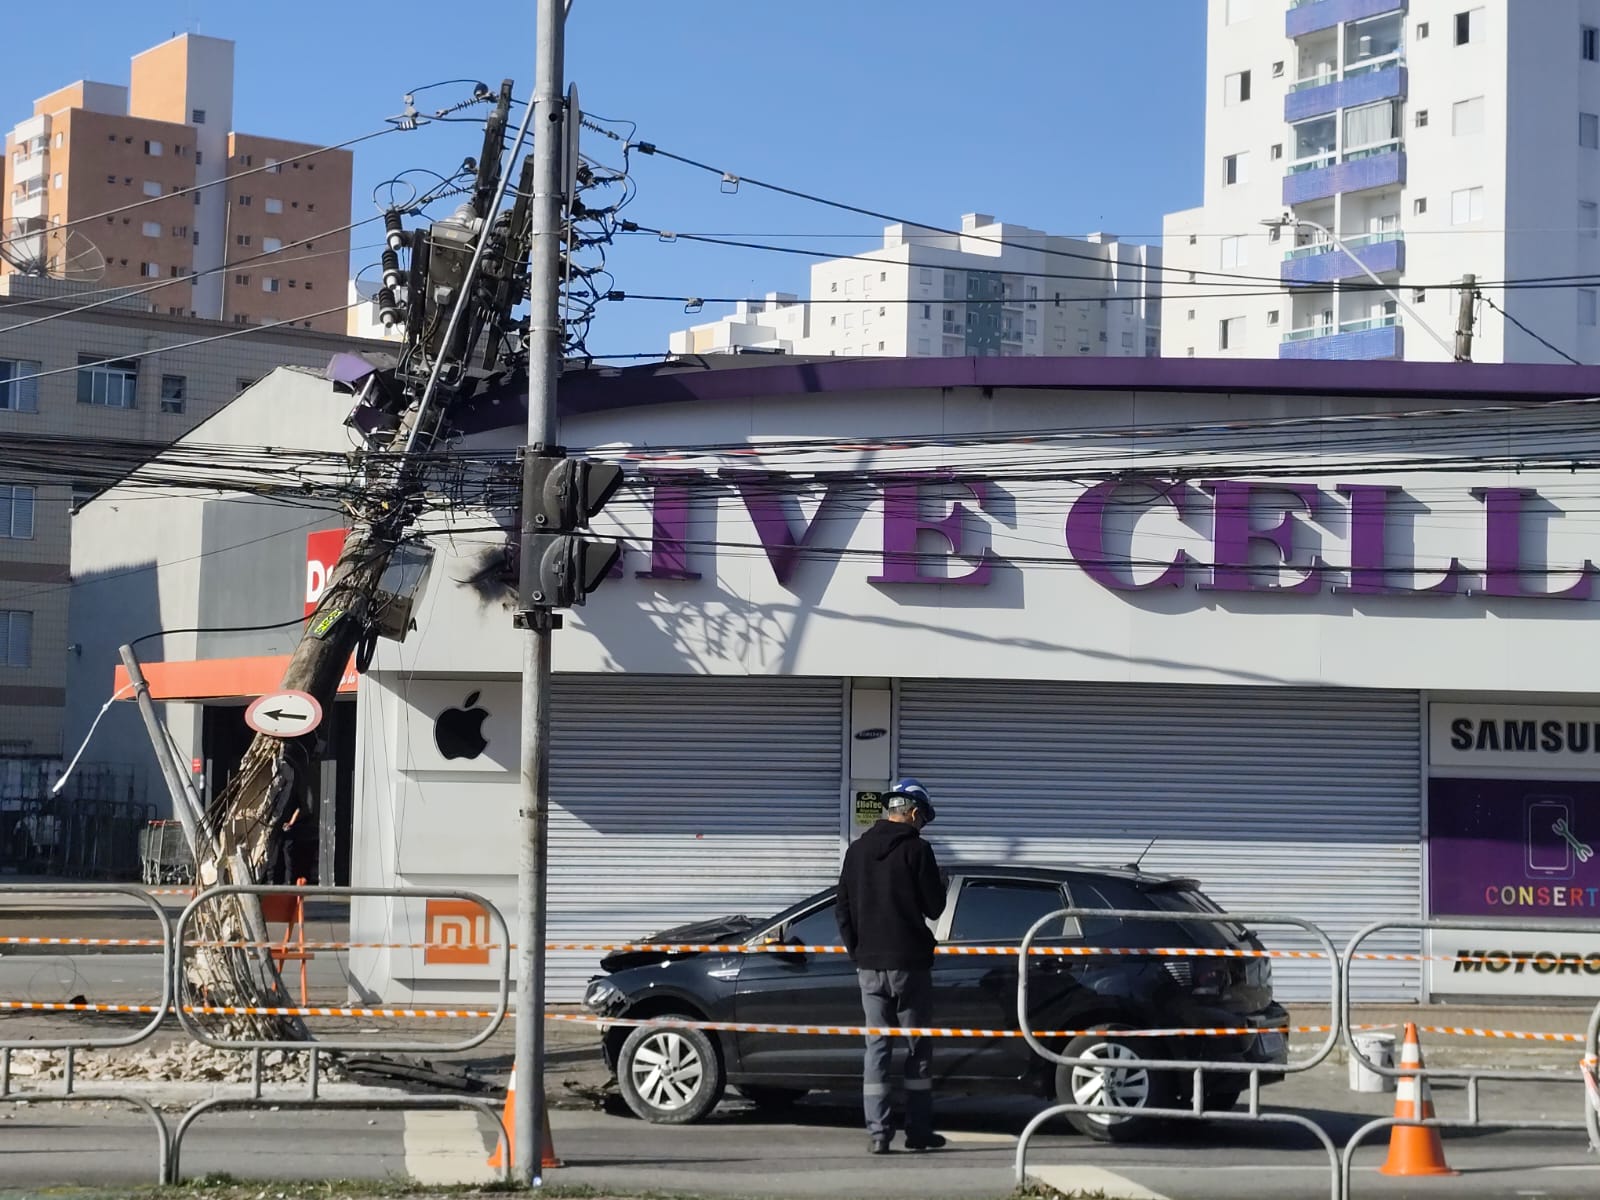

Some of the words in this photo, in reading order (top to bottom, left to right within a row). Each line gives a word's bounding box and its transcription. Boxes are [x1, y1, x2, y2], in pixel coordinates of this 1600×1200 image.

[508, 467, 992, 586] IVE
[1065, 478, 1592, 600] CELL
[1451, 718, 1600, 753] SAMSU
[1485, 886, 1599, 907] CONSERT
